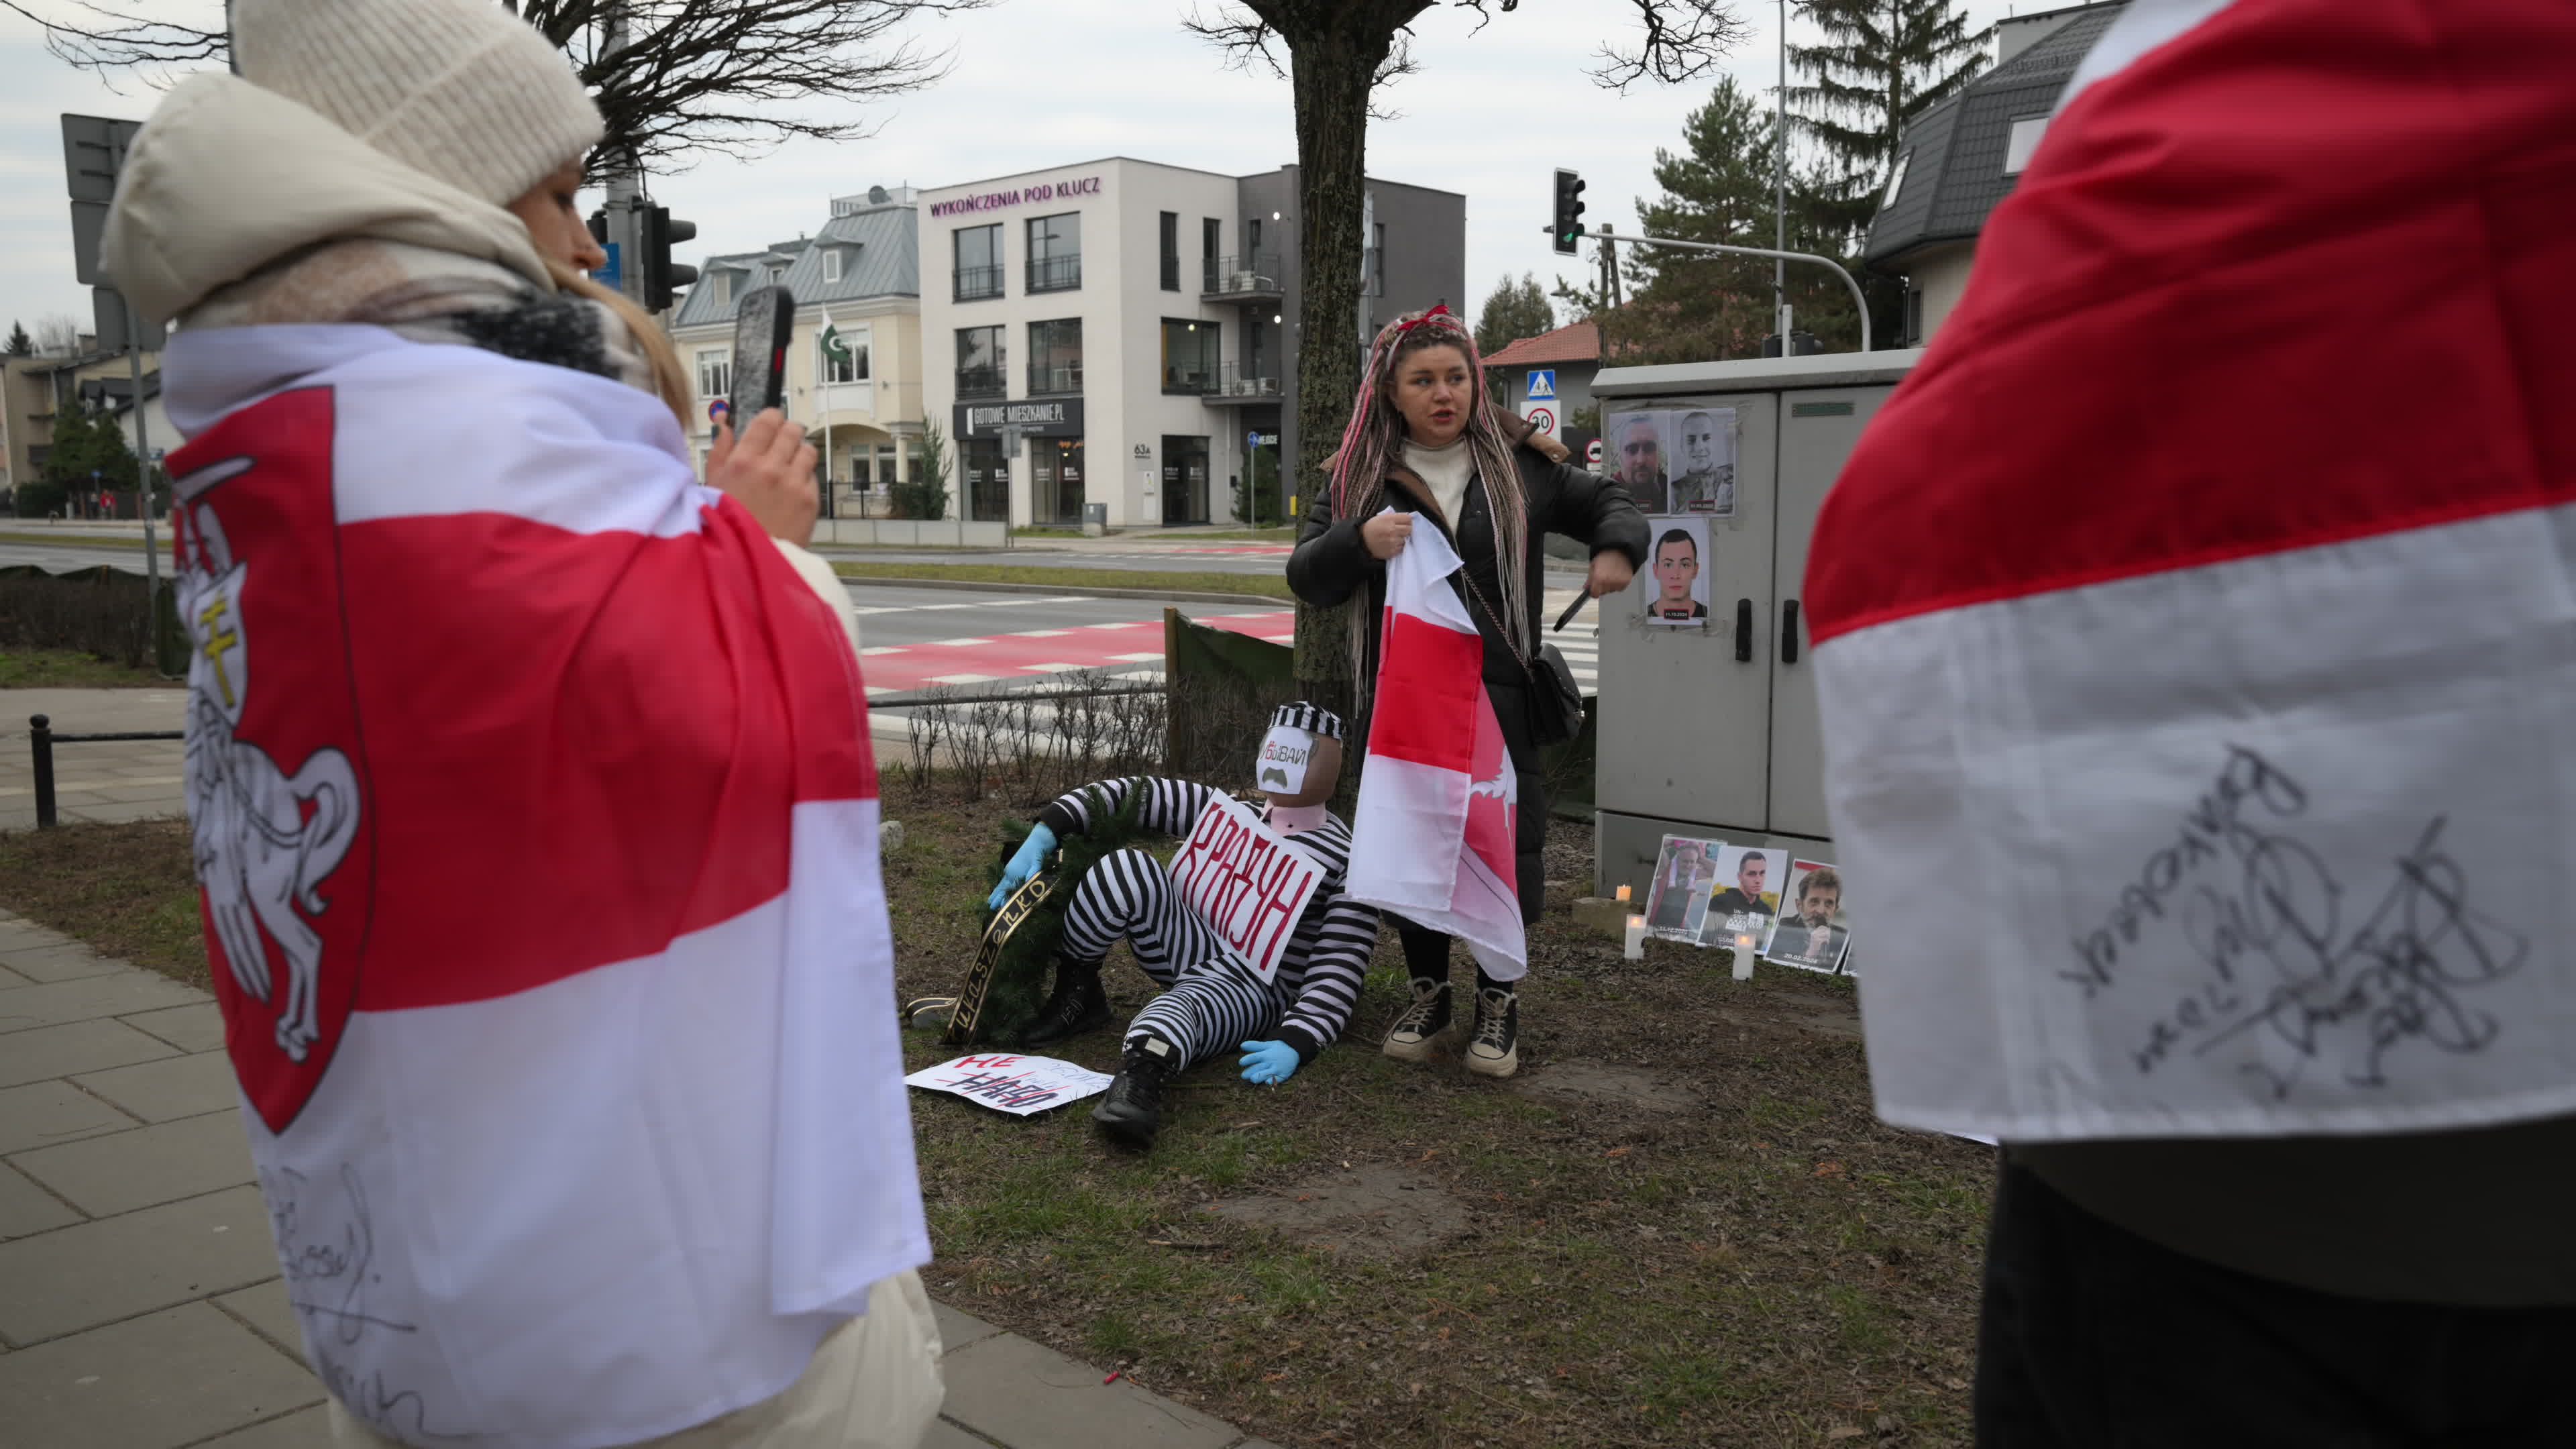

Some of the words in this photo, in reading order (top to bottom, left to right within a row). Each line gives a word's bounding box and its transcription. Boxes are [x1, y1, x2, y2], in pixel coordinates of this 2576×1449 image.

[930, 191, 1020, 217] WYKOŃCZENIA
[1024, 184, 1052, 203] POD
[1057, 177, 1100, 197] KLUCZ
[974, 407, 1005, 424] GOTOWE
[1007, 404, 1065, 423] MIESZKANIE.PL
[953, 1056, 1026, 1069] НЕ
